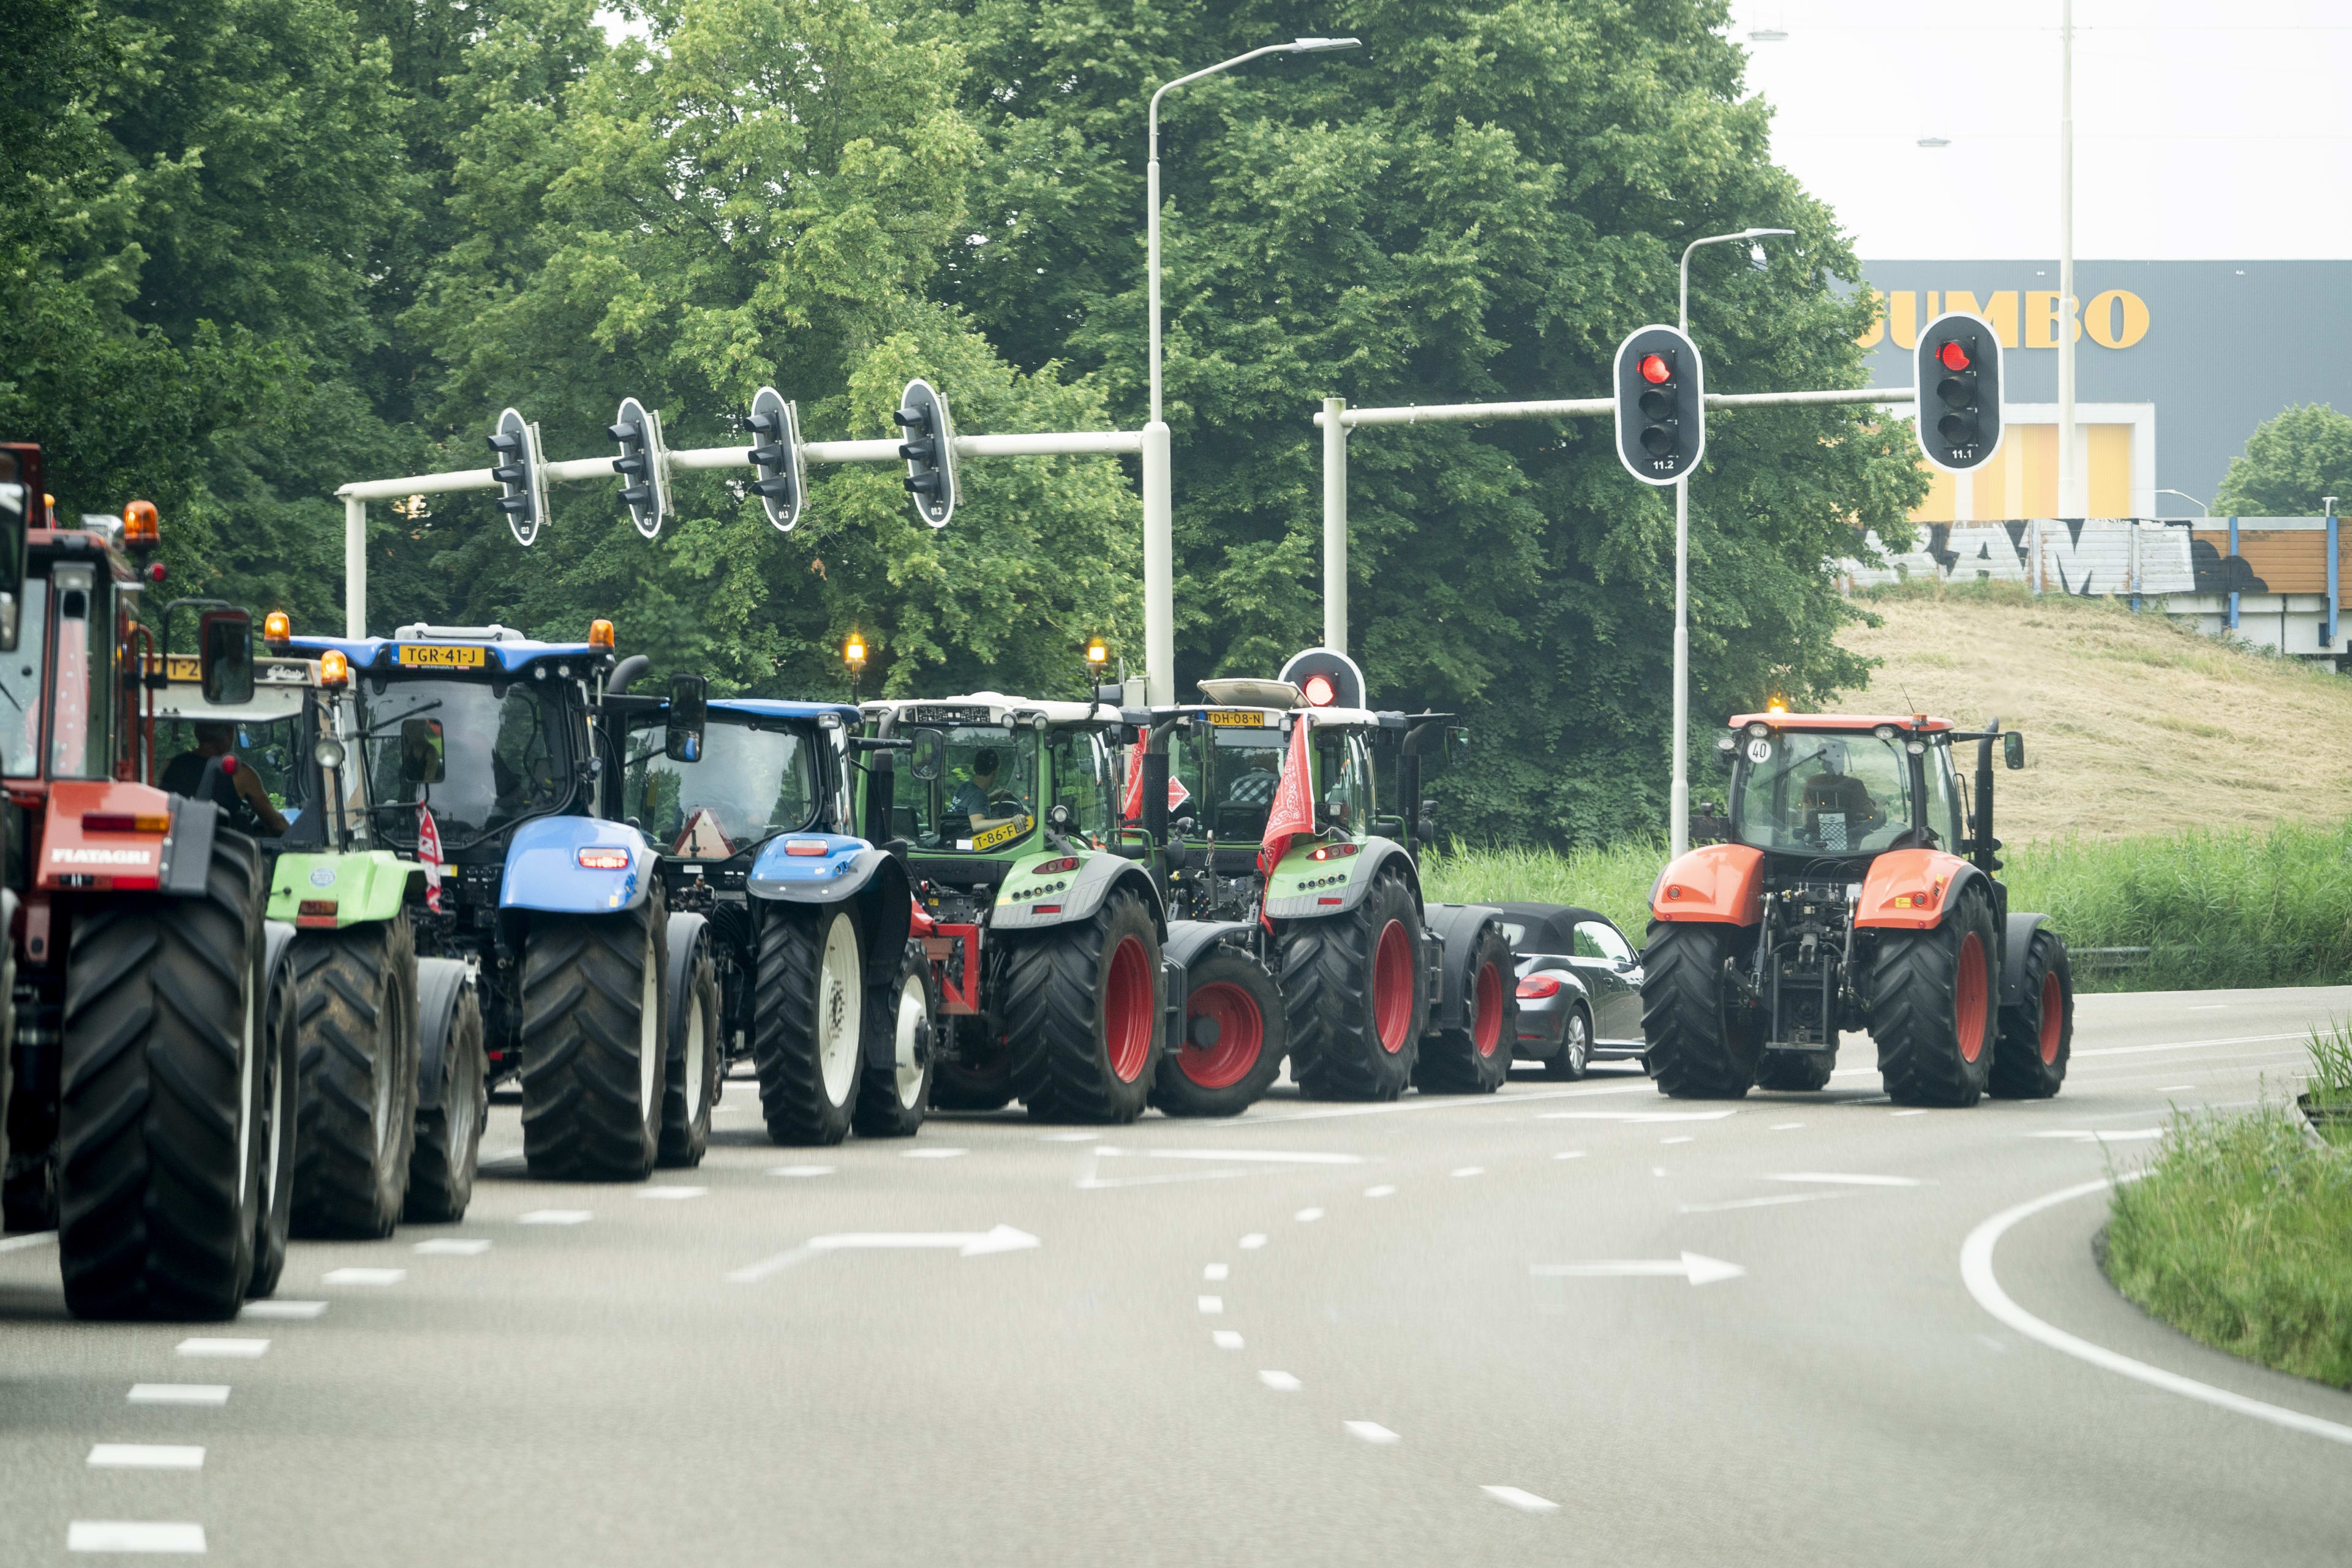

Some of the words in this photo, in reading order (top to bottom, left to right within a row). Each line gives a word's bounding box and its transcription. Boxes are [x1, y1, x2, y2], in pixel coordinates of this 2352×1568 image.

[1952, 450, 1972, 458] 11.1
[1653, 461, 1674, 469] 11.2
[407, 648, 475, 663] TGR-41-J
[1207, 714, 1261, 724] TDH-08-N
[1752, 743, 1766, 758] 40
